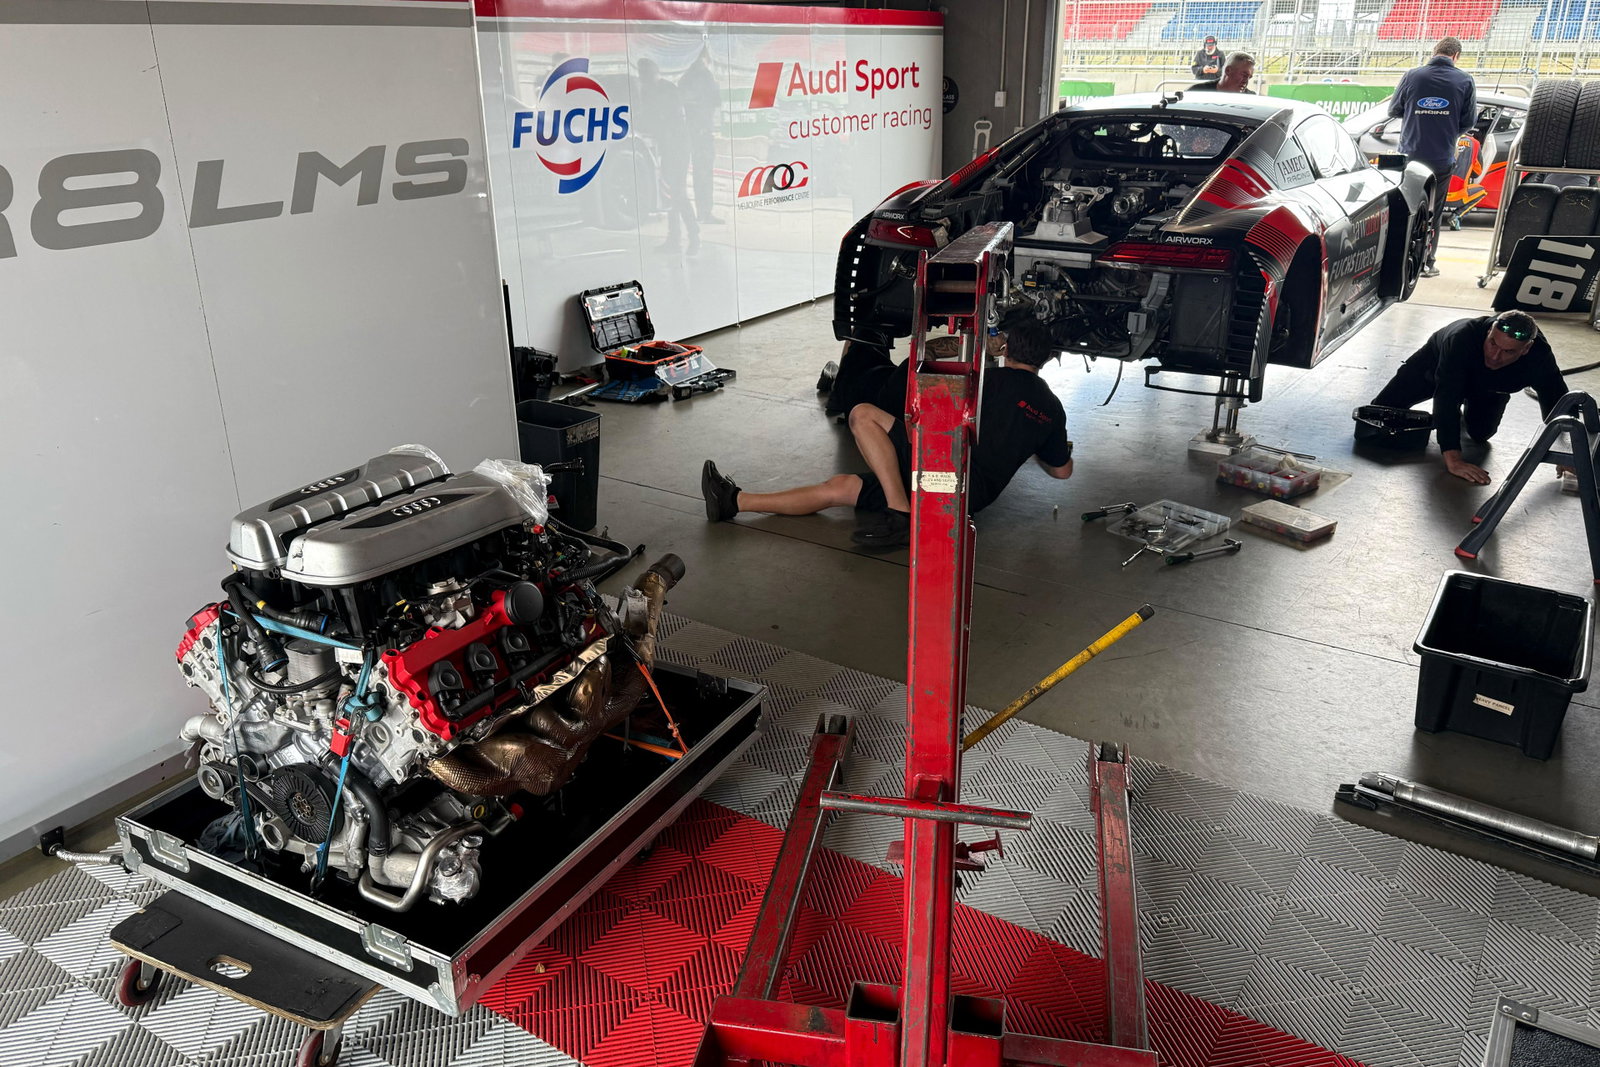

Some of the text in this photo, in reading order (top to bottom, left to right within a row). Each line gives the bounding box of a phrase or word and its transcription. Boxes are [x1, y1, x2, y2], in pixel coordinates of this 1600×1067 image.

[787, 59, 919, 99] Audi Sport
[789, 104, 932, 139] customer racing
[1315, 101, 1380, 115] SHANNO
[512, 105, 629, 148] FUCHS
[1277, 155, 1306, 183] JAMEC
[0, 138, 470, 259] 8 LMS
[1165, 235, 1214, 245] AIRWORX
